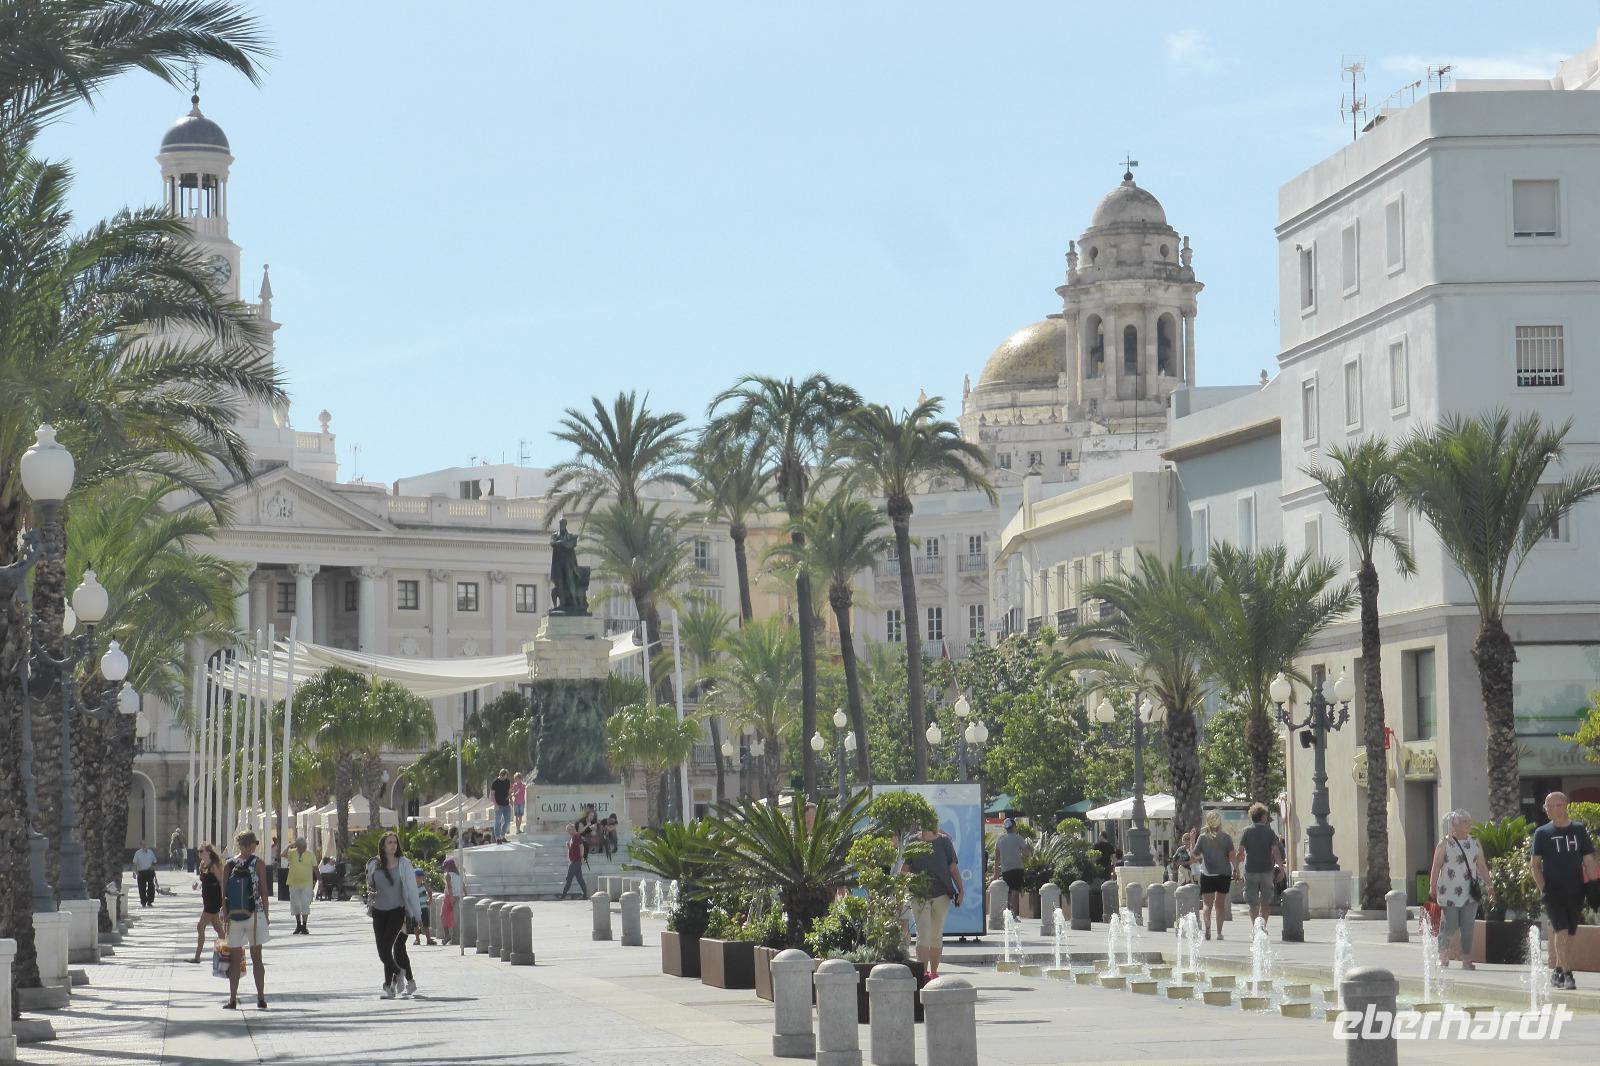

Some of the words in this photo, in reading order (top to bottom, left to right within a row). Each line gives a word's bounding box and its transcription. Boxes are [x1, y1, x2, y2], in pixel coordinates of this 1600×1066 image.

[541, 802, 568, 813] CADIZ
[570, 803, 576, 813] A
[1551, 834, 1578, 853] TH
